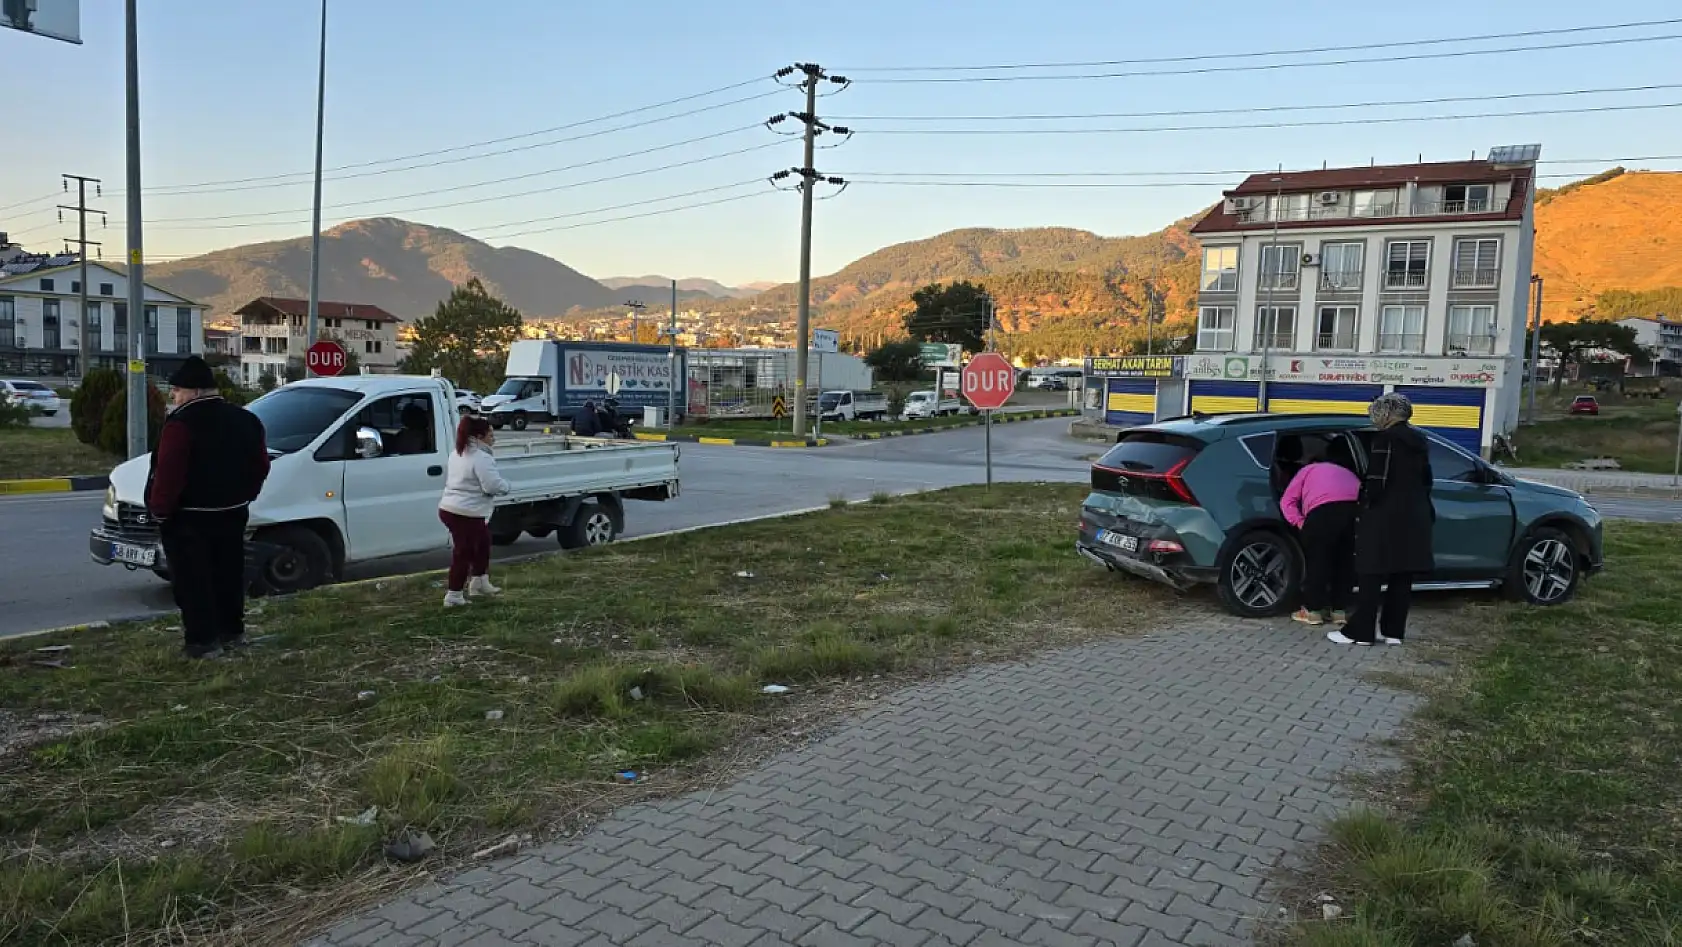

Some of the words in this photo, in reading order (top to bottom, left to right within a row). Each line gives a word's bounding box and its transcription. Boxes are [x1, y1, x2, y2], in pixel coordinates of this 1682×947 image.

[309, 351, 343, 367] DUR
[1093, 358, 1121, 370] SERHAT
[1121, 358, 1145, 370] AKAN
[1145, 358, 1172, 370] TARIM
[647, 365, 677, 378] KAS
[967, 370, 1009, 392] DUR
